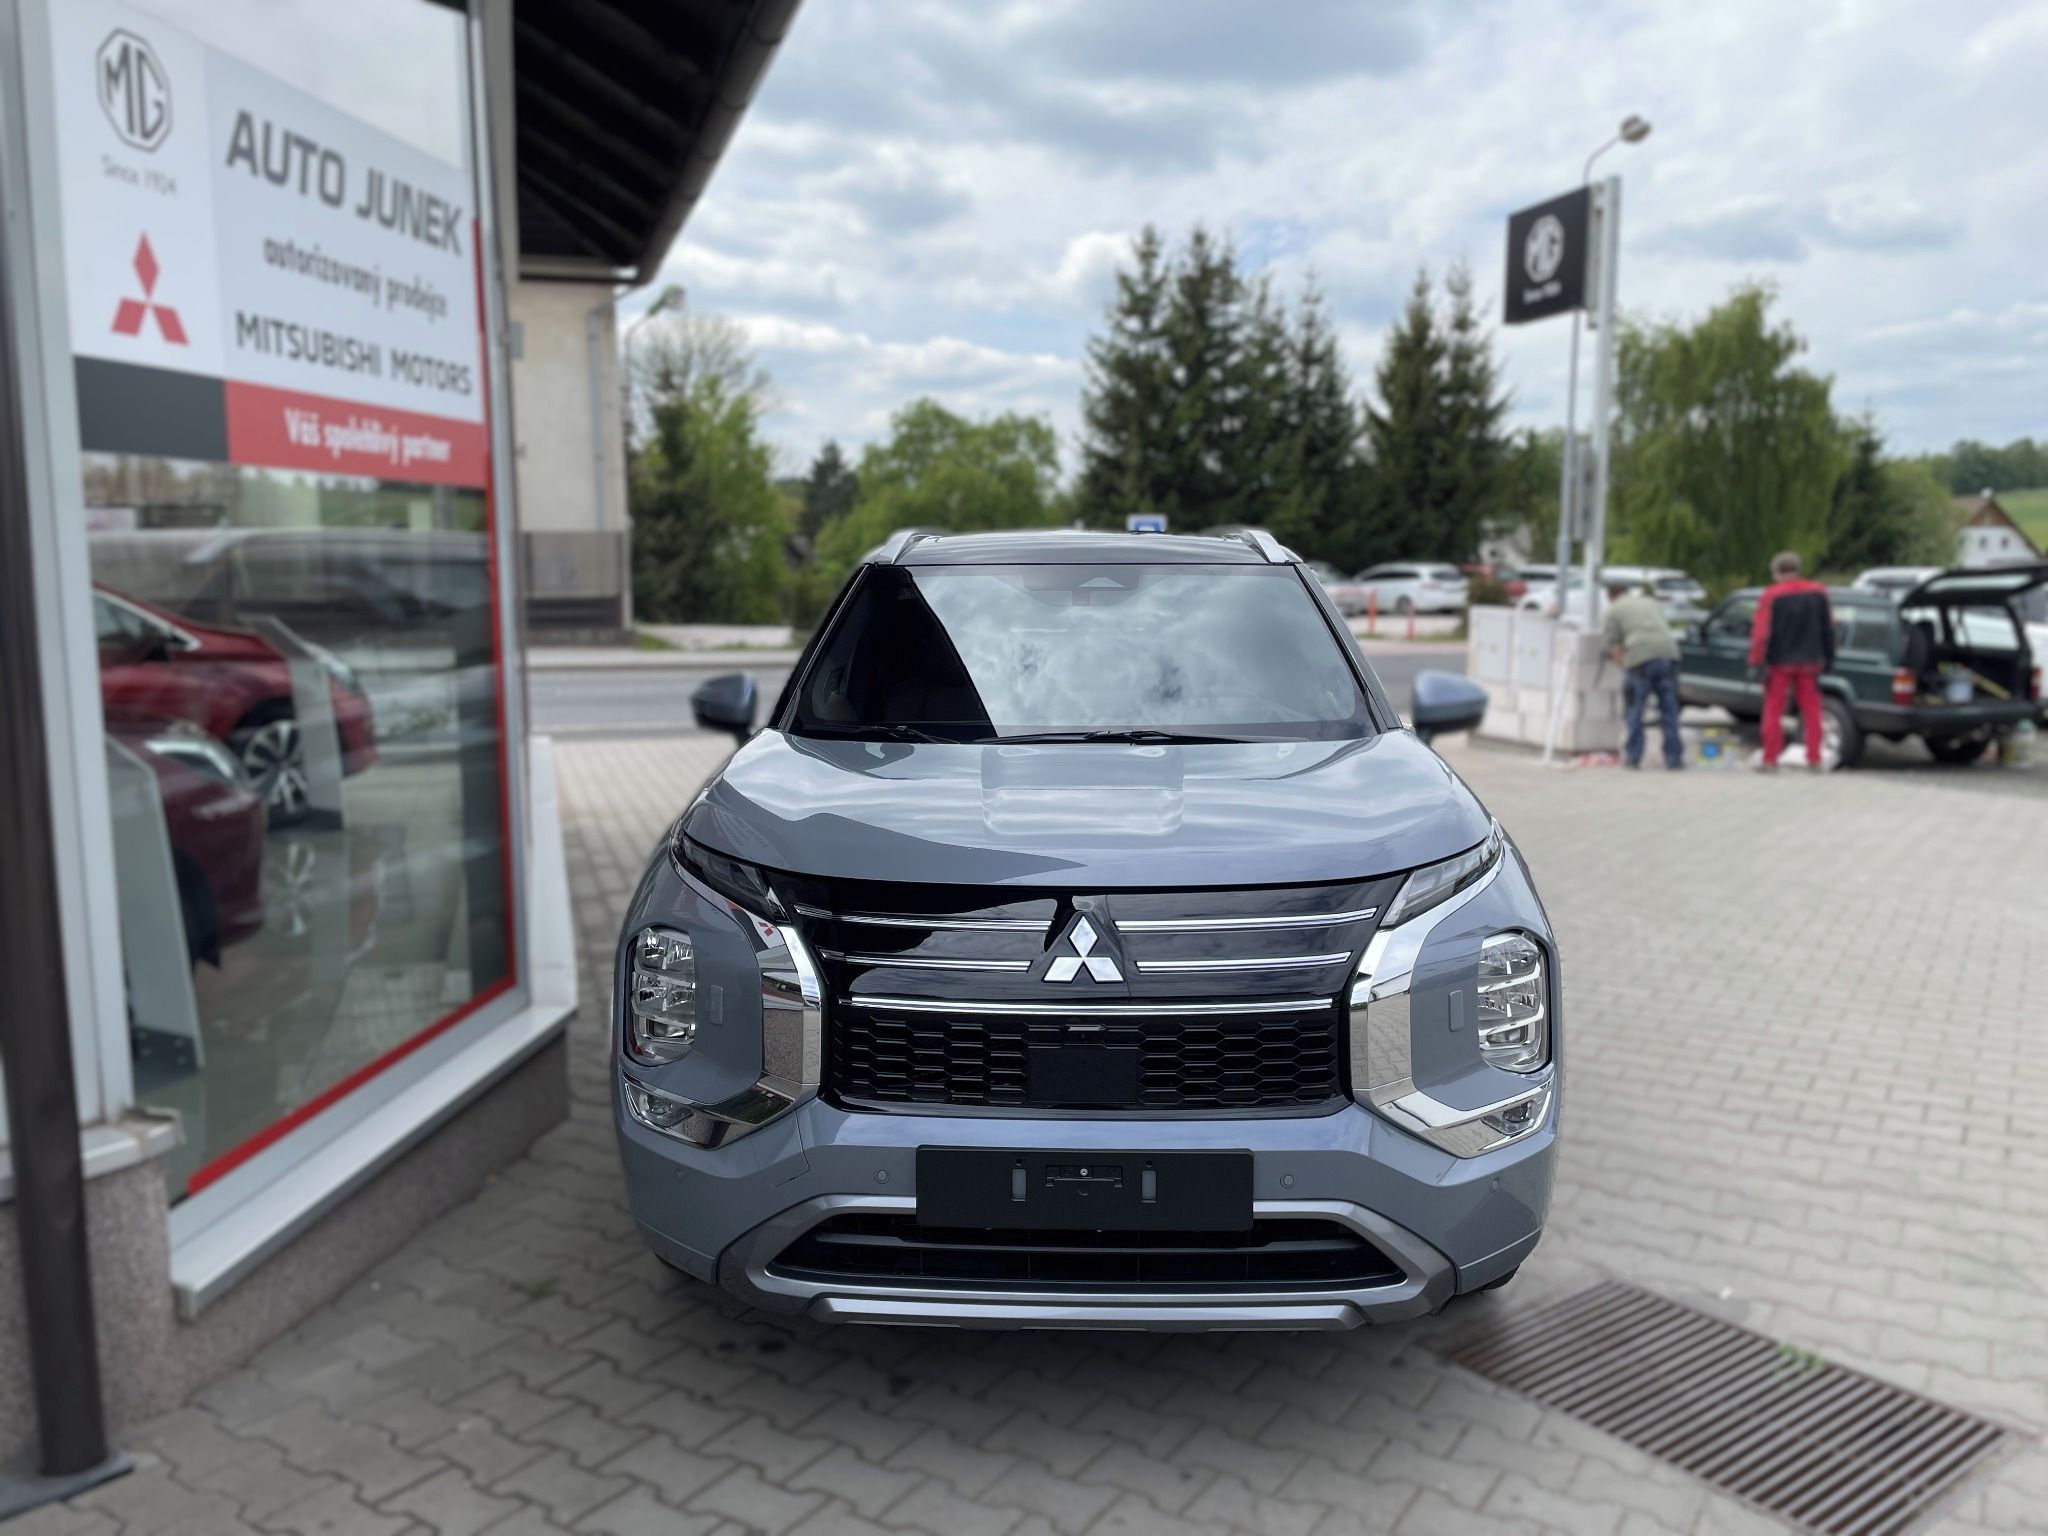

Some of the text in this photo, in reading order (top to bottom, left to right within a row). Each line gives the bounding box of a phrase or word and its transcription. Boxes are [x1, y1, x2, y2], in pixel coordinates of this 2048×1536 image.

[103, 40, 164, 141] MG
[226, 108, 463, 256] AUTO JUNEK
[236, 310, 472, 396] MITSUBISHI MOTORS
[402, 432, 451, 467] partner
